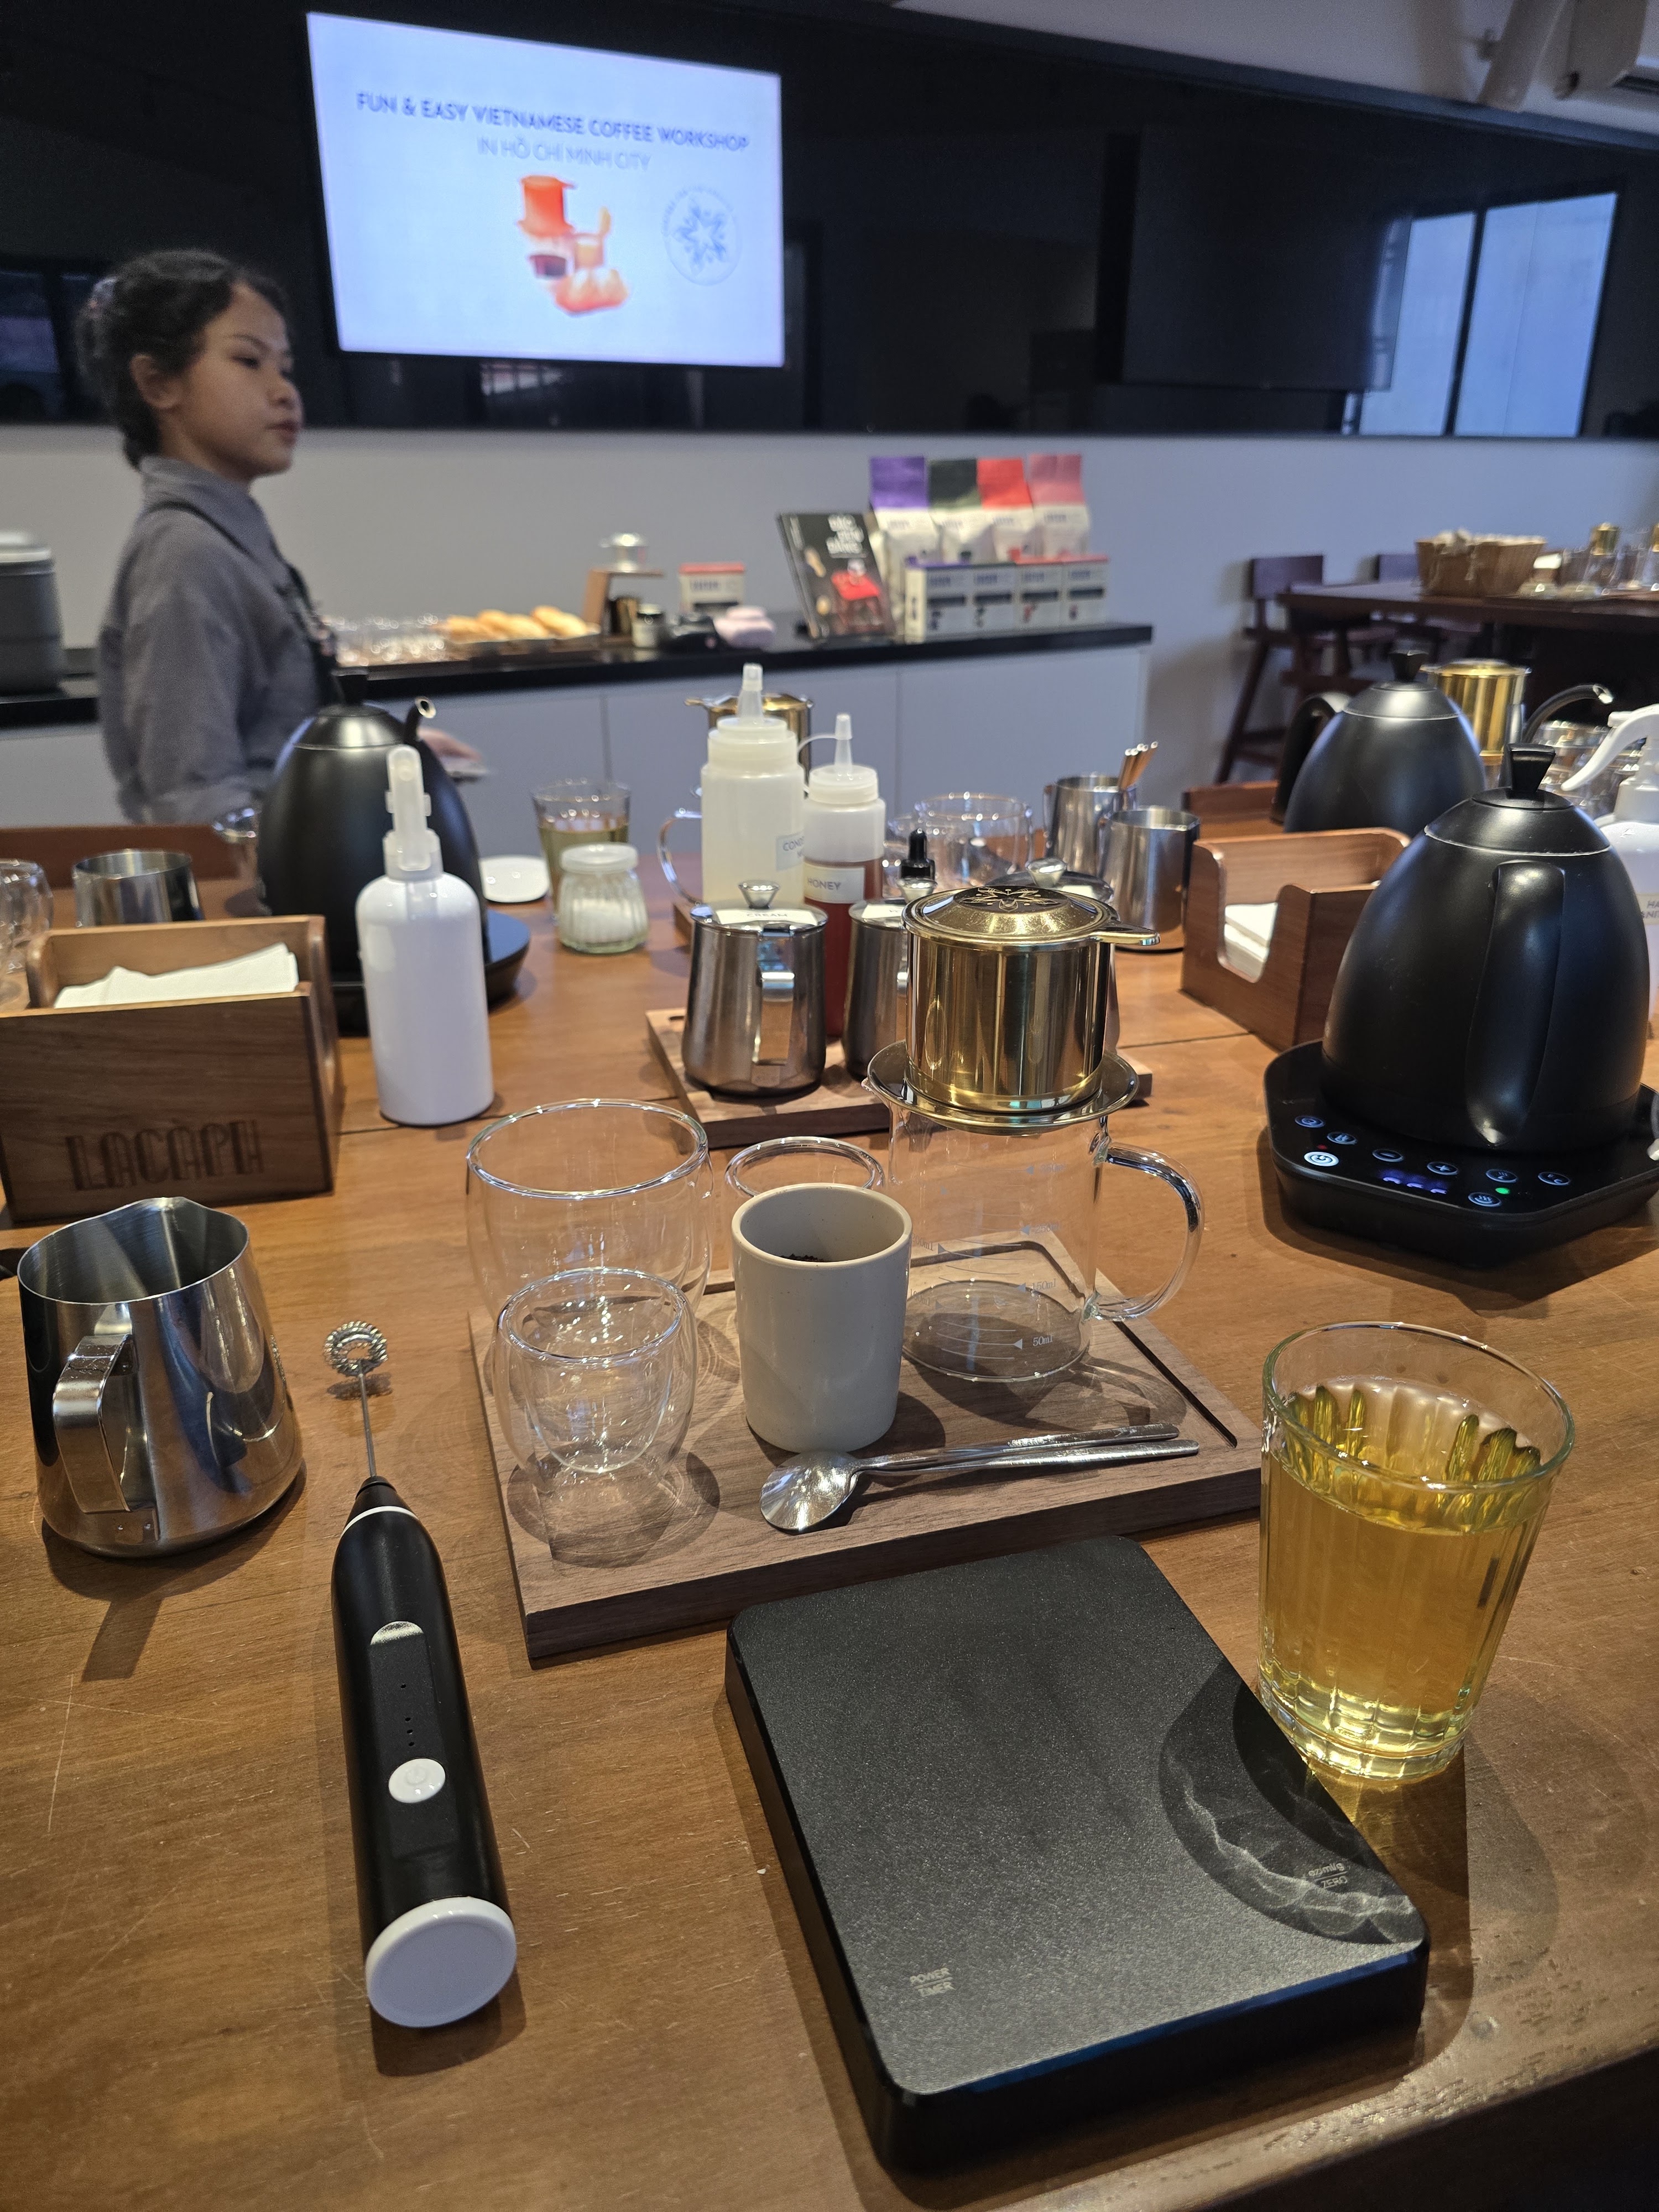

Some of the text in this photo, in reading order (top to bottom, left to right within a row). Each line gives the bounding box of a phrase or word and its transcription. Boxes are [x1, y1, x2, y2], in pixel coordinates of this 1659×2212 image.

[356, 92, 749, 152] FUN & EASY VIETNAMESE COFFEE WORKSHOP
[614, 149, 651, 170] CITY
[807, 878, 841, 891] HONEY
[1032, 1278, 1056, 1291] 150ml
[1032, 1335, 1053, 1347] 50ml
